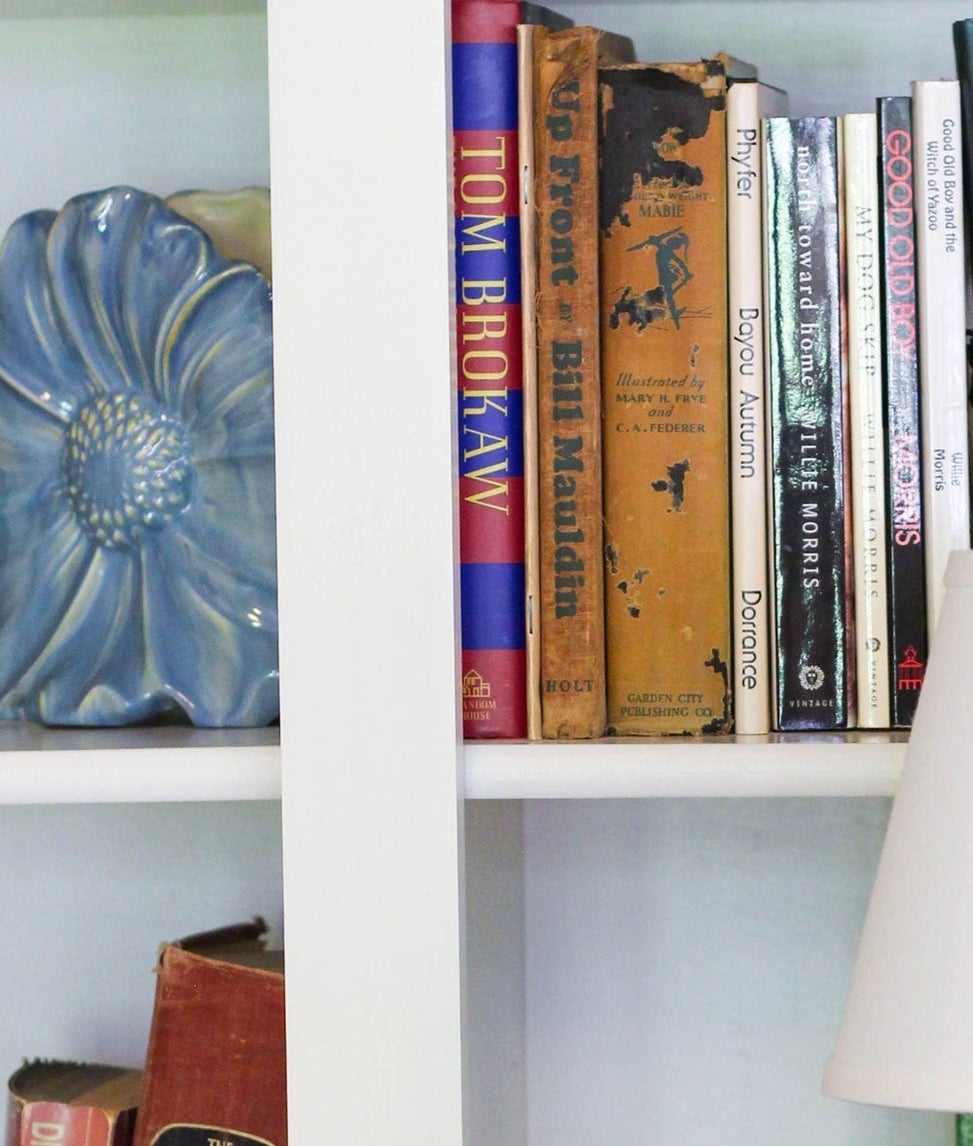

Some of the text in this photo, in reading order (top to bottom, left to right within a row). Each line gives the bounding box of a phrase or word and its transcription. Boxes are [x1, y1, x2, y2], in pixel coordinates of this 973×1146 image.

[546, 78, 581, 287] Up Front
[730, 128, 756, 199] Phyfer
[886, 129, 914, 228] GOOD
[926, 141, 940, 231] Witch of Yazoo
[942, 118, 957, 253] Good Old Boy and the
[639, 204, 685, 217] MABIE
[855, 206, 873, 242] MY
[797, 146, 820, 388] north toward home
[856, 253, 875, 311] DOG
[888, 235, 915, 296] OLD
[459, 136, 509, 516] TOM BROKAW
[890, 303, 917, 361] BOY
[615, 393, 706, 403] MARY H. FRYE
[616, 373, 706, 391] Illustrated by
[648, 405, 674, 417] and
[733, 308, 760, 479] Bayou Autumn
[650, 423, 706, 433] FEDERER
[552, 340, 586, 620] Bill Mauldin
[893, 434, 921, 546] MORRIS
[934, 448, 946, 492] Morris
[950, 452, 963, 487] Willie
[800, 412, 820, 589] WILLIE MORRIS
[741, 590, 762, 690] Dorrance
[546, 679, 594, 693] HOLT
[620, 707, 688, 718] PUBLISHING
[627, 693, 704, 703] GARDEN CITY
